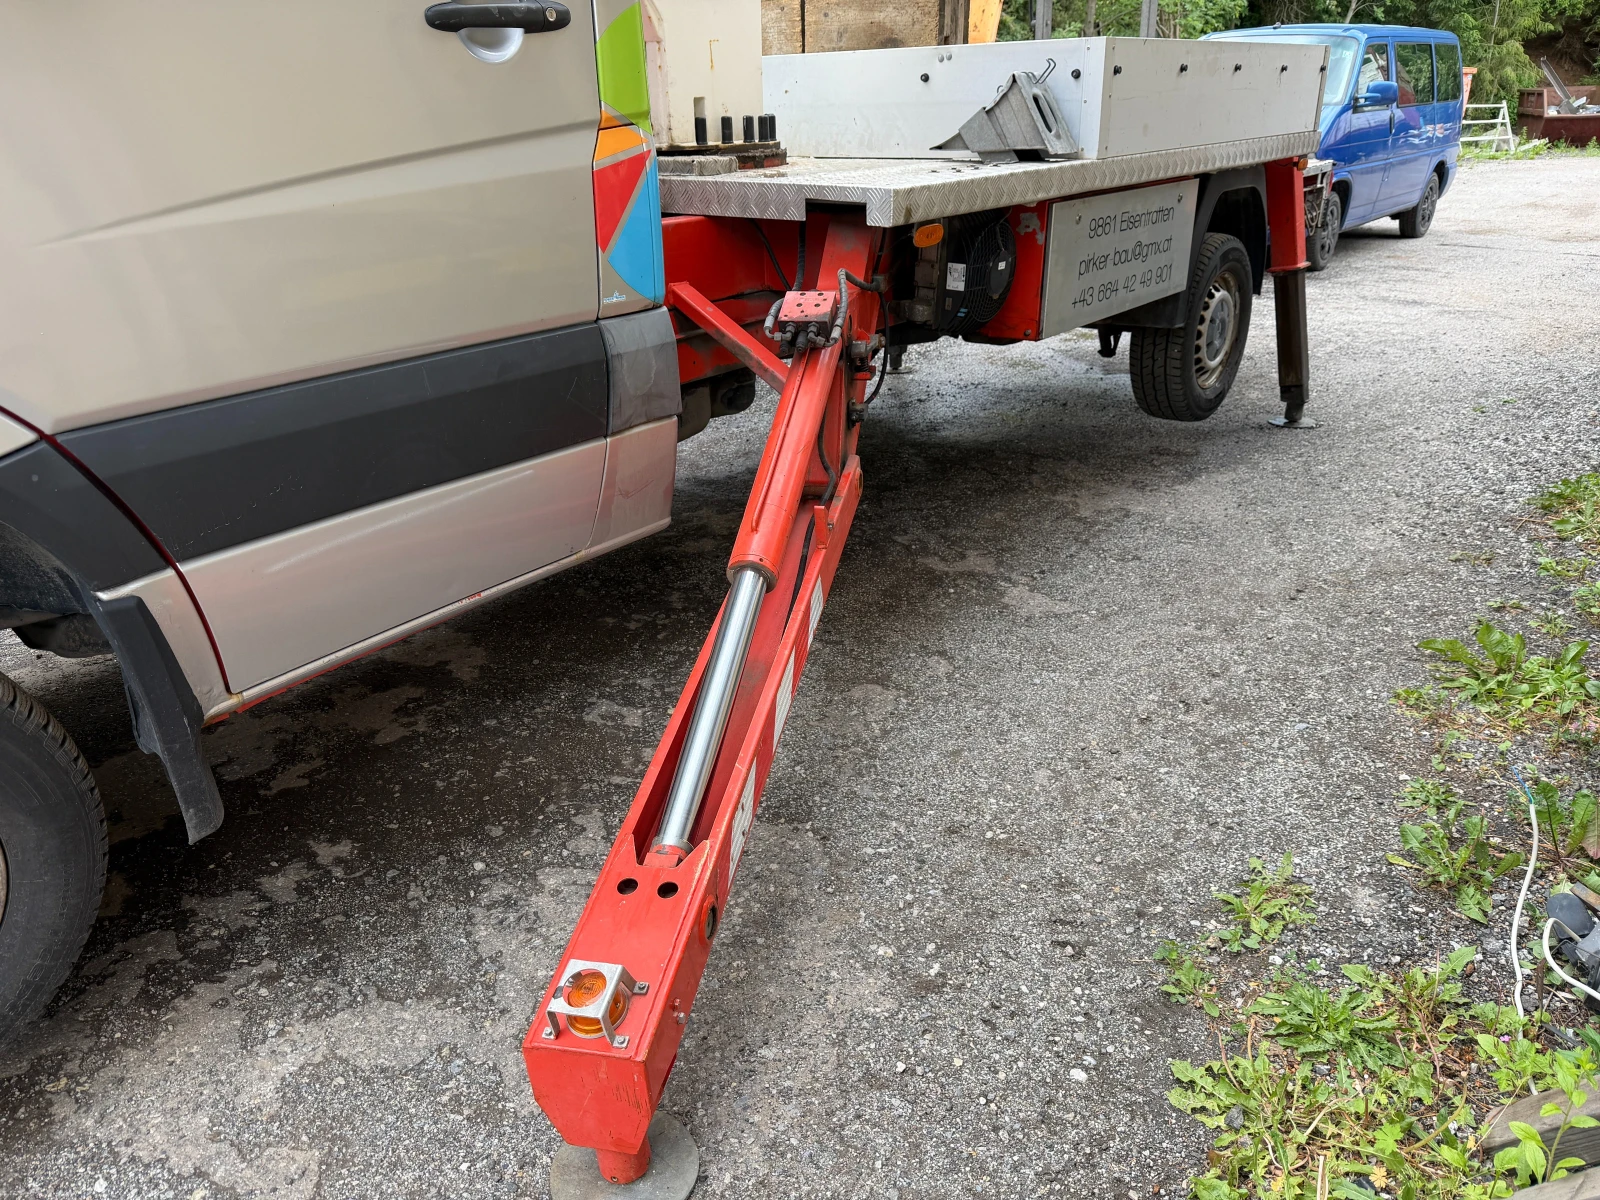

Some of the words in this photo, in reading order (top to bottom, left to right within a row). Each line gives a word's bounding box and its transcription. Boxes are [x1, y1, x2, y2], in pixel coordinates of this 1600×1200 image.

[1088, 214, 1117, 239] 9861
[1120, 206, 1175, 232] Eisentratten
[1078, 235, 1173, 281] pirker-bau@gmx.at
[1071, 286, 1095, 309] +43
[1097, 279, 1120, 303] 664
[1122, 274, 1137, 294] 42
[1140, 269, 1153, 288] 49
[1155, 263, 1173, 285] 901
